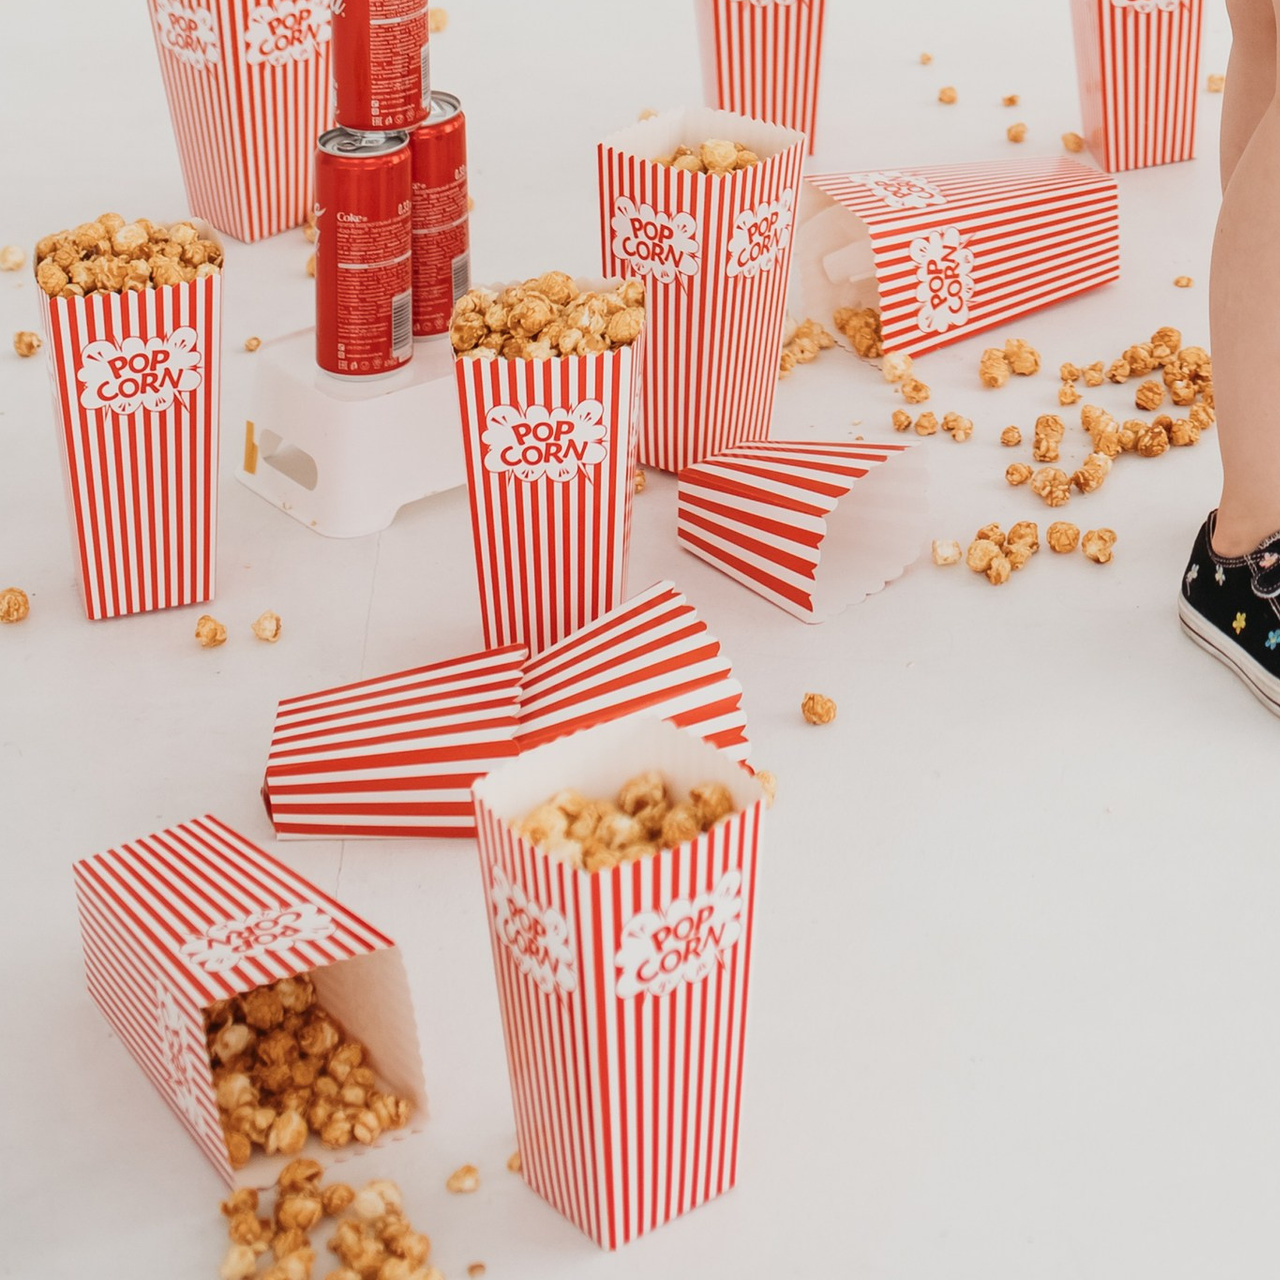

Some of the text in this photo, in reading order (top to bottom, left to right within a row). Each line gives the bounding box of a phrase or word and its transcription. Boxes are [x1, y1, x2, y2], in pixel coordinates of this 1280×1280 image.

[169, 13, 198, 35] POP
[268, 9, 311, 36] POP
[166, 29, 207, 55] CORN
[259, 24, 321, 56] CORN
[875, 181, 912, 199] POP
[629, 217, 674, 244] POP
[747, 211, 779, 245] POP
[622, 236, 684, 269] CORN
[737, 227, 783, 268] CORN
[926, 259, 948, 310] POP
[941, 244, 964, 314] CORN
[107, 349, 170, 380] POP
[96, 367, 184, 402] CORN
[511, 420, 575, 446] POP
[500, 438, 589, 467] CORN
[207, 911, 303, 950] CORN
[507, 896, 547, 941] POP
[651, 905, 715, 952] POP
[231, 925, 302, 953] POP
[503, 918, 560, 977] CORN
[635, 923, 725, 983] CORN
